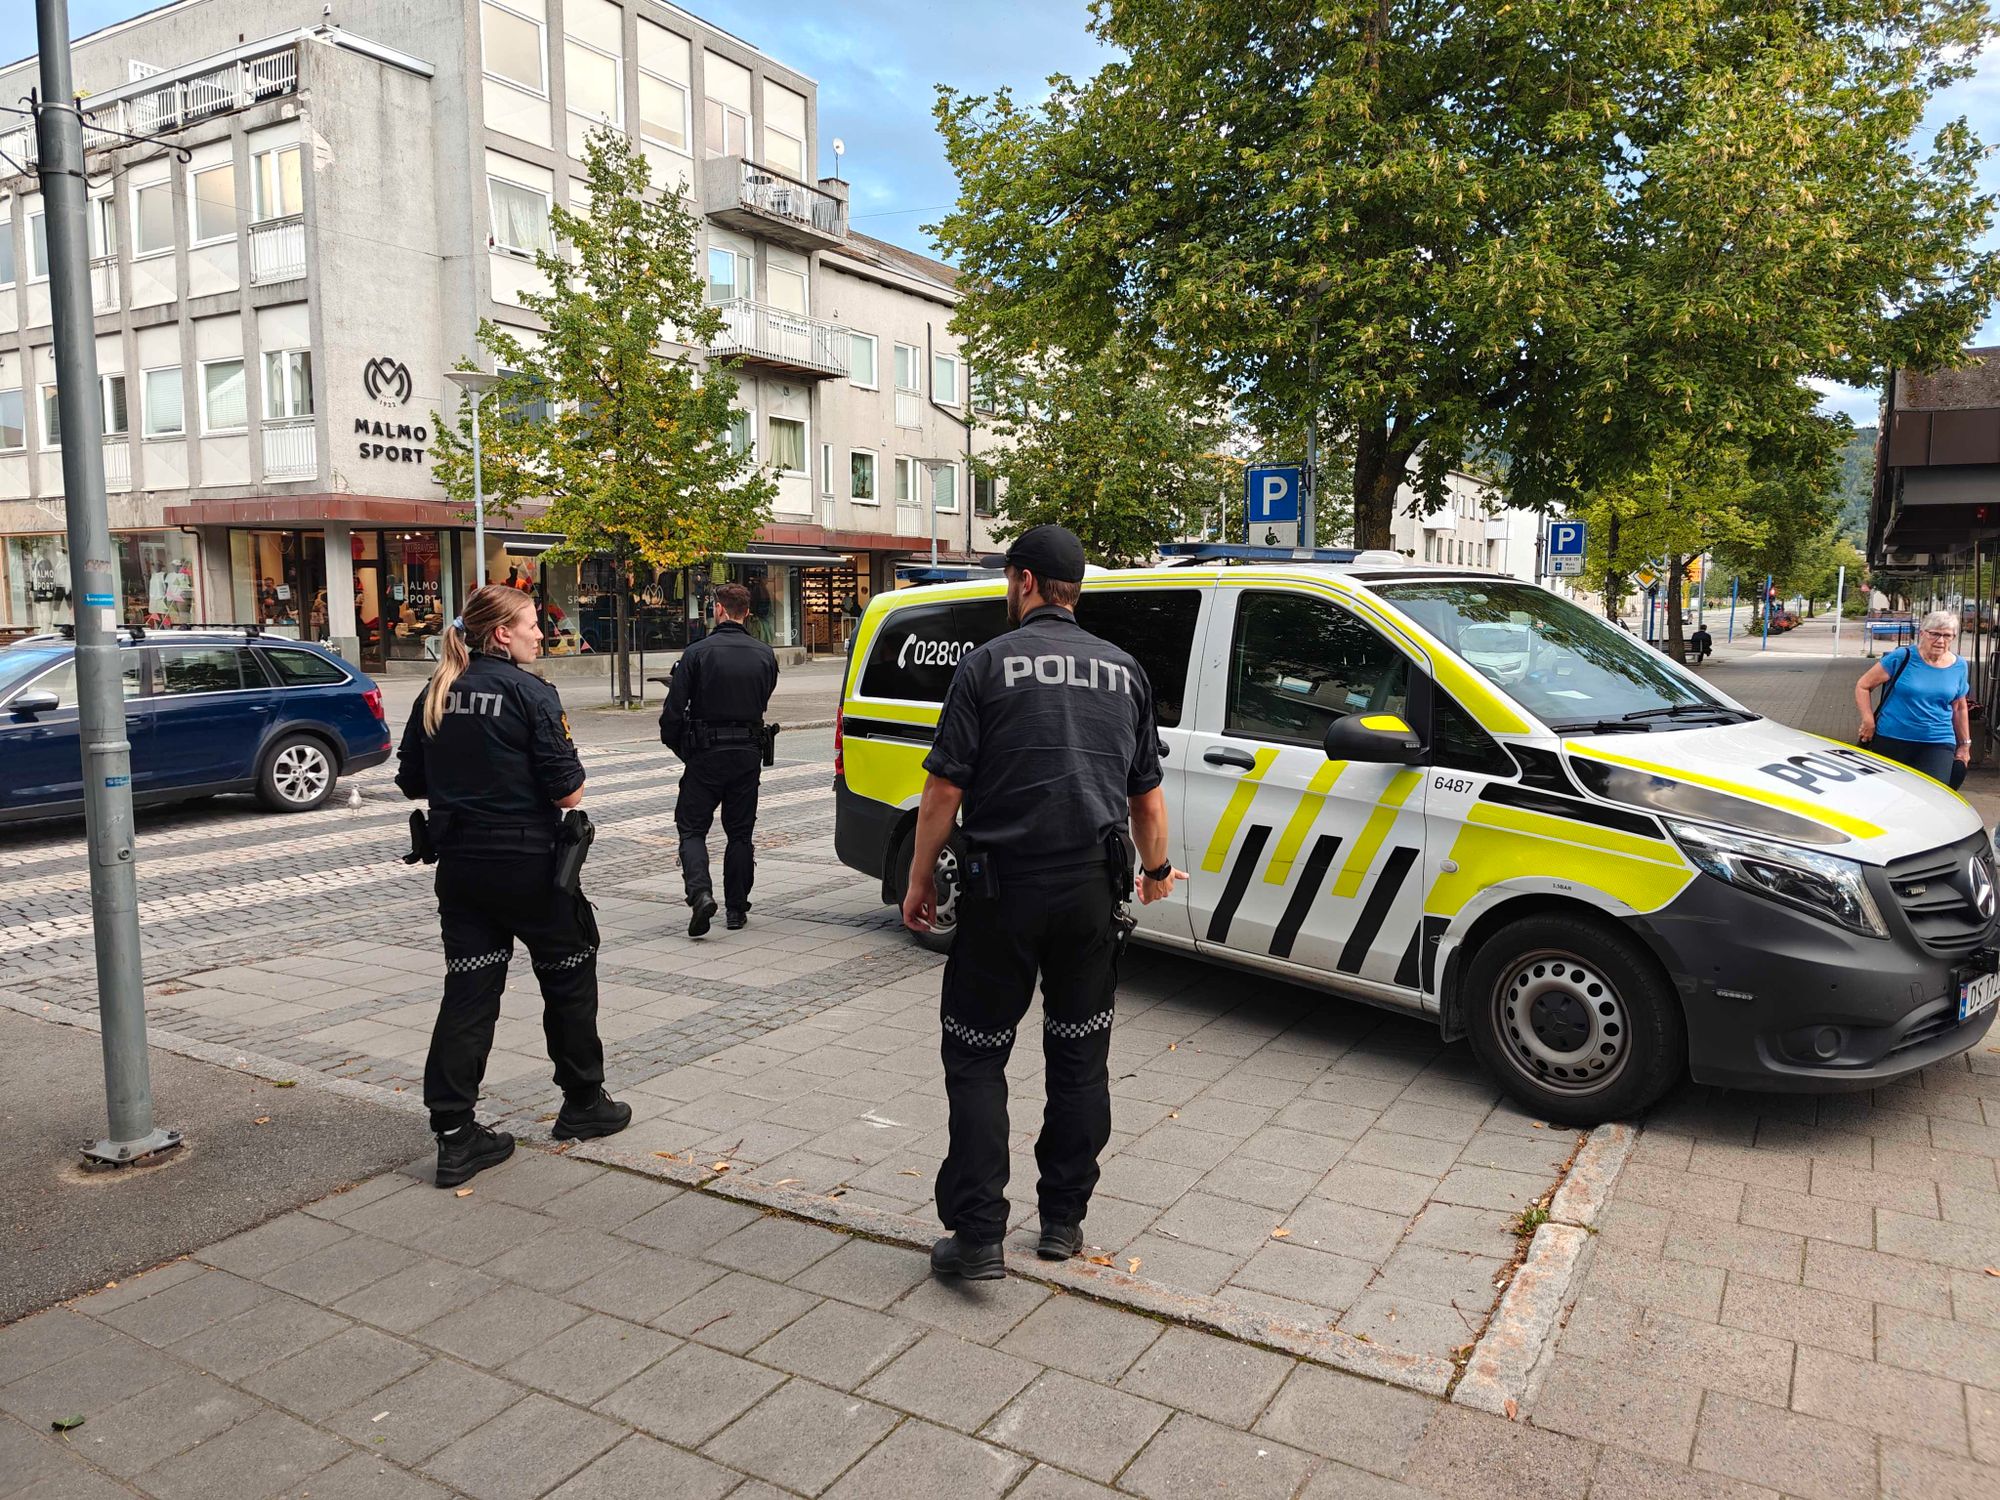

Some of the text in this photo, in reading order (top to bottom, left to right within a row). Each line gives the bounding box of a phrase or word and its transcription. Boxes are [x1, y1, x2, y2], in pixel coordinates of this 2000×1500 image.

[354, 418, 427, 442] MALMO
[359, 442, 425, 464] SPORT
[1262, 476, 1288, 516] P
[1558, 527, 1576, 551] P
[33, 582, 54, 591] SPORT
[565, 583, 600, 592] MALMO
[1003, 655, 1131, 695] POLITI
[442, 691, 503, 717] OLITI
[1757, 749, 1906, 795] POLITI
[1434, 776, 1474, 794] 6487
